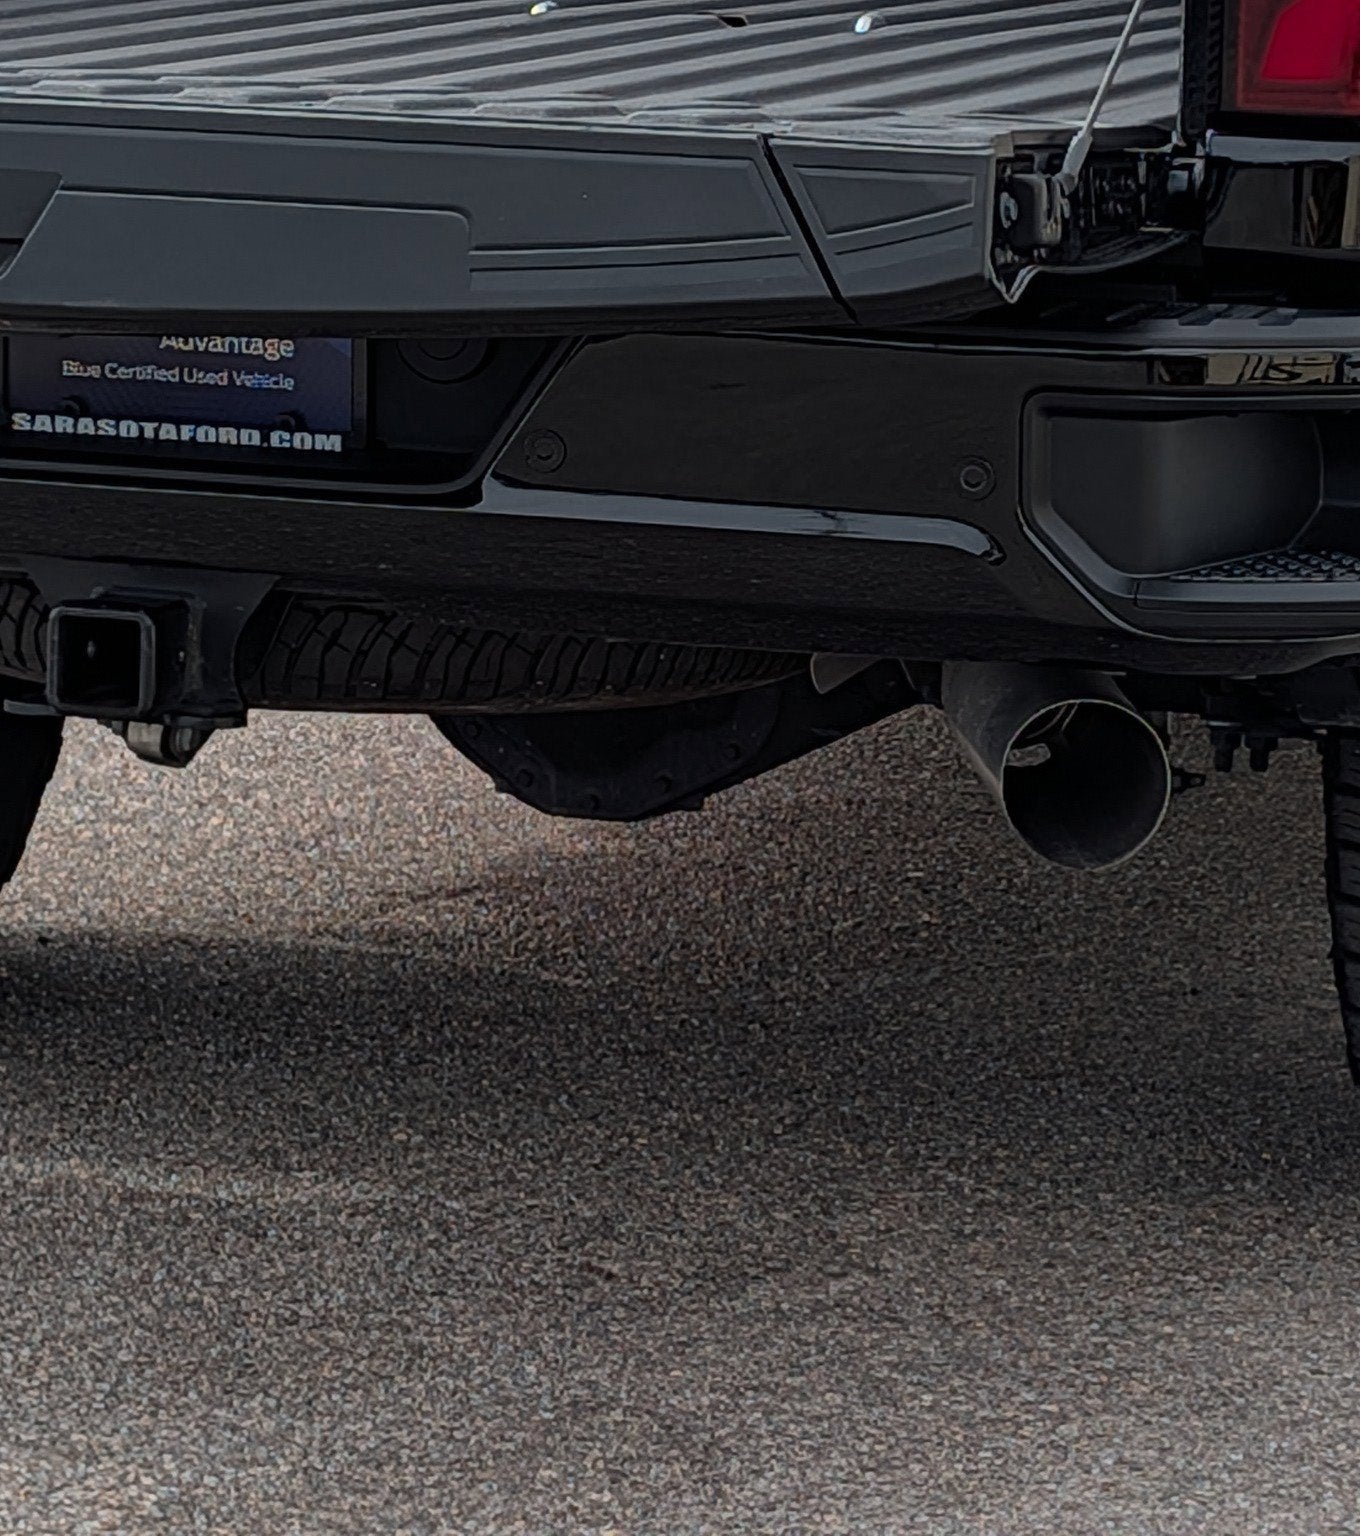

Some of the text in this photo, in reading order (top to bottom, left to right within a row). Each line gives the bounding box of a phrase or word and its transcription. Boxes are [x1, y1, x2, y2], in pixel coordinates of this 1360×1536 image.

[62, 360, 295, 391] Blue Certified Used Vehicle
[11, 412, 343, 453] SARASOTAFORD.COM
